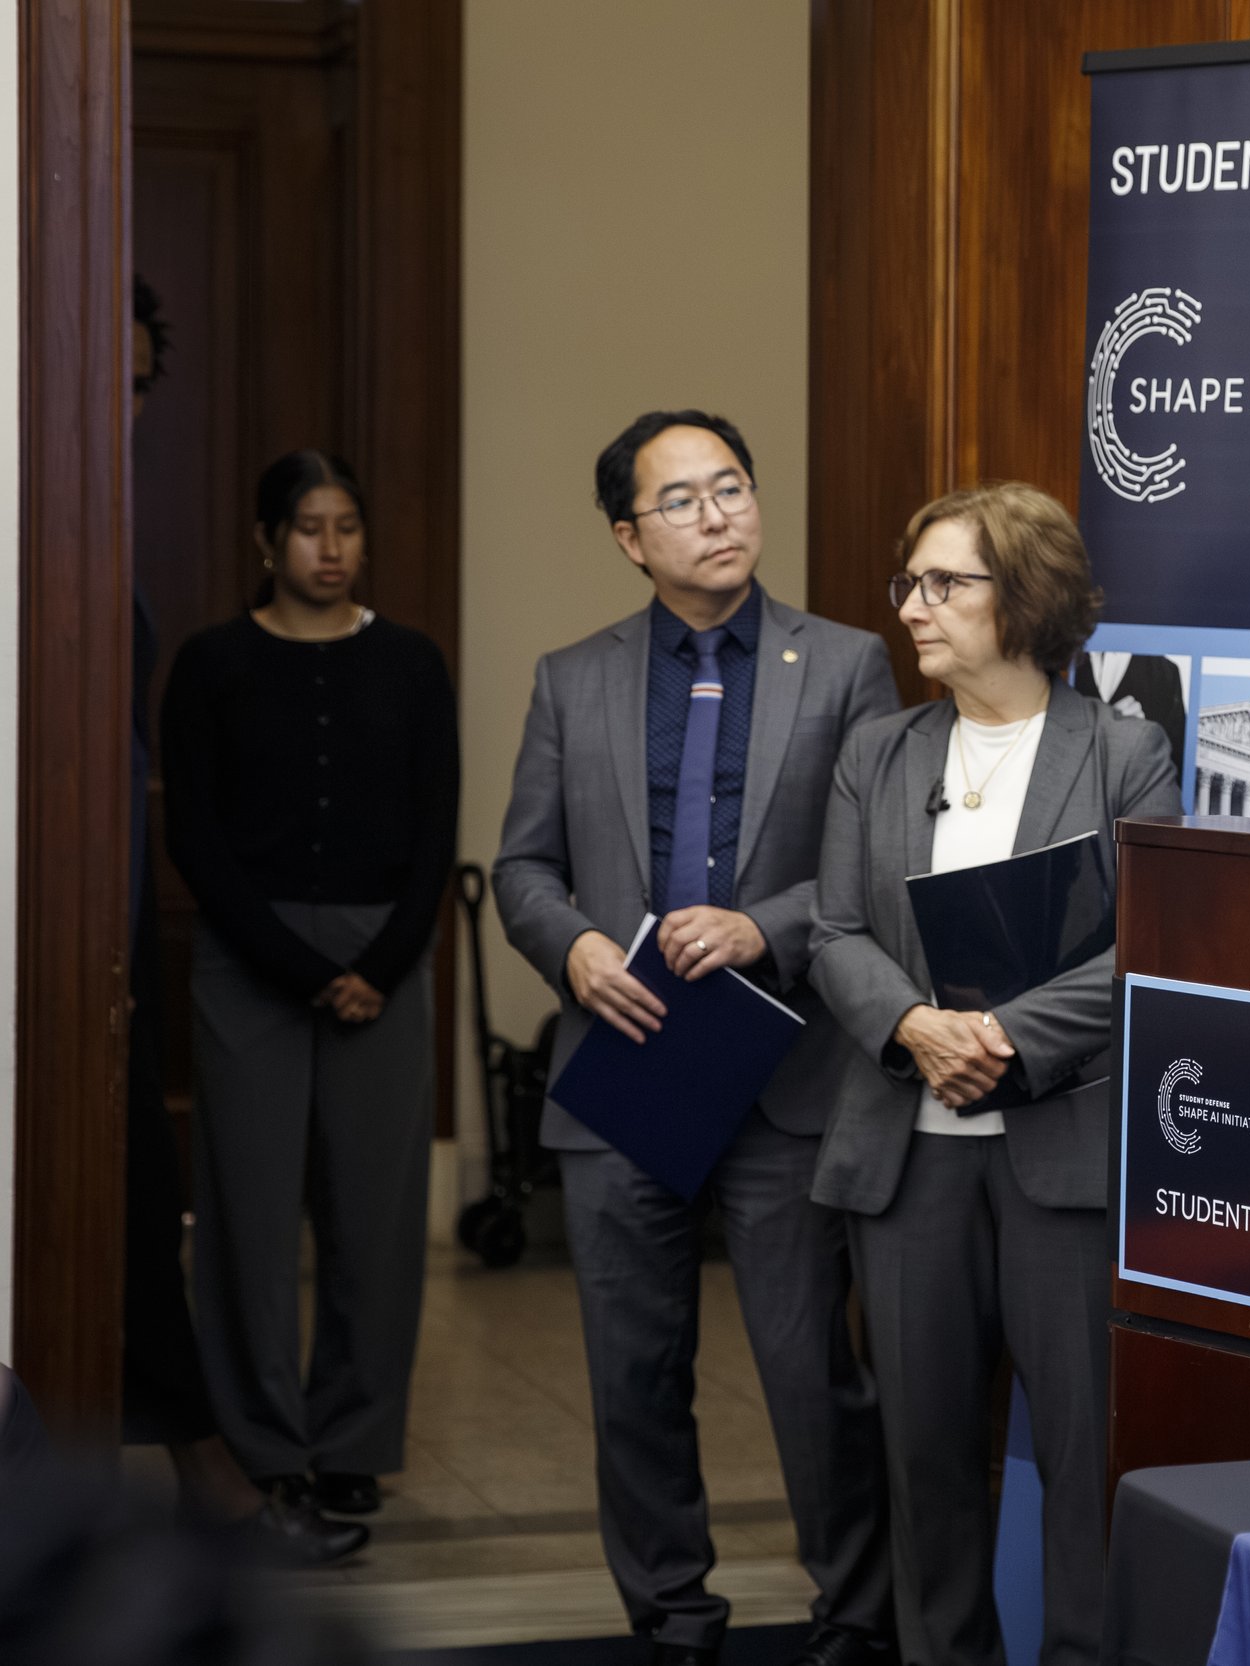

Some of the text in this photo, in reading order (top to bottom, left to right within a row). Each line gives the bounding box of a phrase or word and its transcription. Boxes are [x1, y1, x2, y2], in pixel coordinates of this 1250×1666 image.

[1129, 377, 1245, 414] SHAPE
[1179, 1094, 1230, 1109] STUDENT DEFENSE
[1178, 1105, 1209, 1121] SHAPE
[1210, 1111, 1220, 1123] AI
